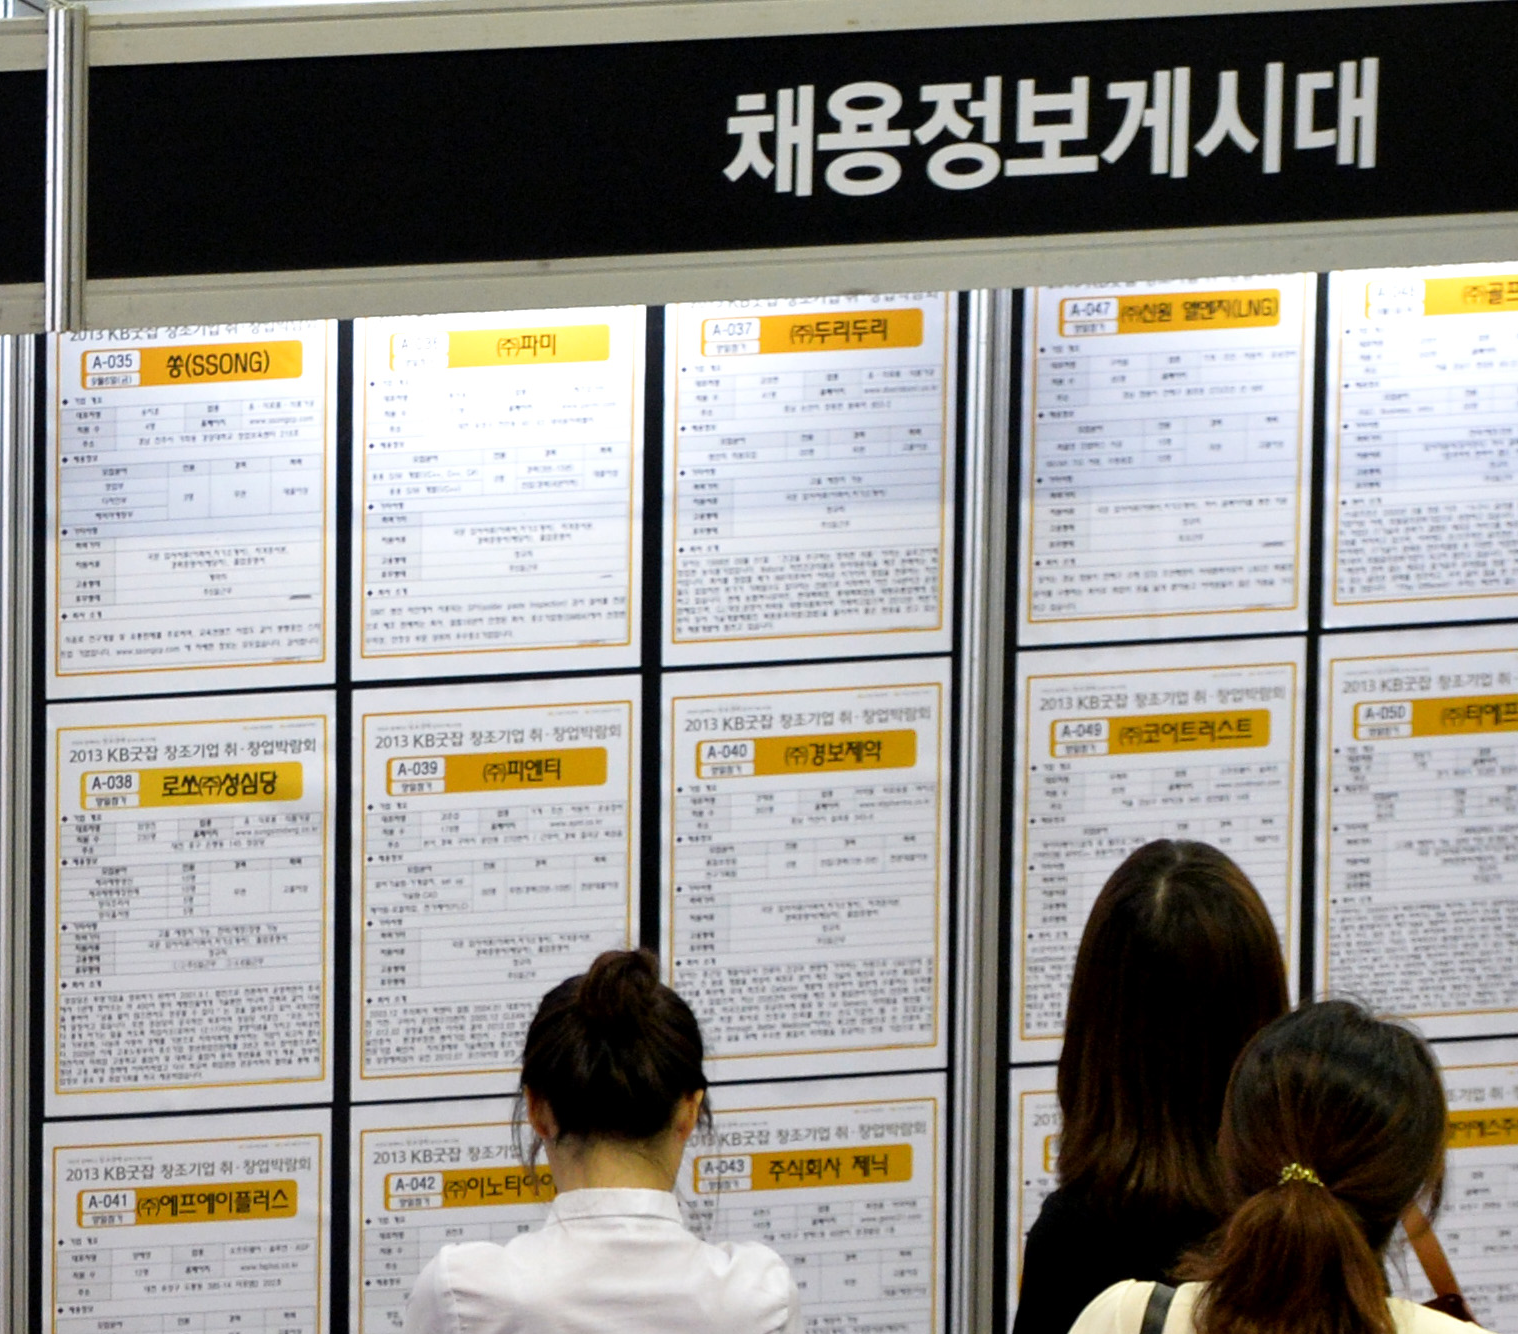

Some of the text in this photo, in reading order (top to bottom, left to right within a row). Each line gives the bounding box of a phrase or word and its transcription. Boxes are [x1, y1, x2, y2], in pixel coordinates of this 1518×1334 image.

[722, 57, 1380, 198] 채용정보게시대
[1070, 301, 1111, 317] A-047
[92, 353, 133, 370] A-035
[686, 717, 719, 733] 2013
[780, 711, 835, 730] 창조기업
[1061, 722, 1103, 738] A-049
[374, 734, 409, 750] 2013
[68, 748, 104, 764] 2013
[164, 743, 220, 761] 창조기업
[707, 743, 748, 759] A-040
[397, 760, 438, 776] A-039
[91, 774, 133, 790] A-038
[65, 1167, 100, 1182] 2013
[160, 1161, 215, 1180] 창조기업
[770, 1157, 841, 1182] 주식회사
[395, 1176, 436, 1191] A-042
[88, 1193, 127, 1209] A-041
